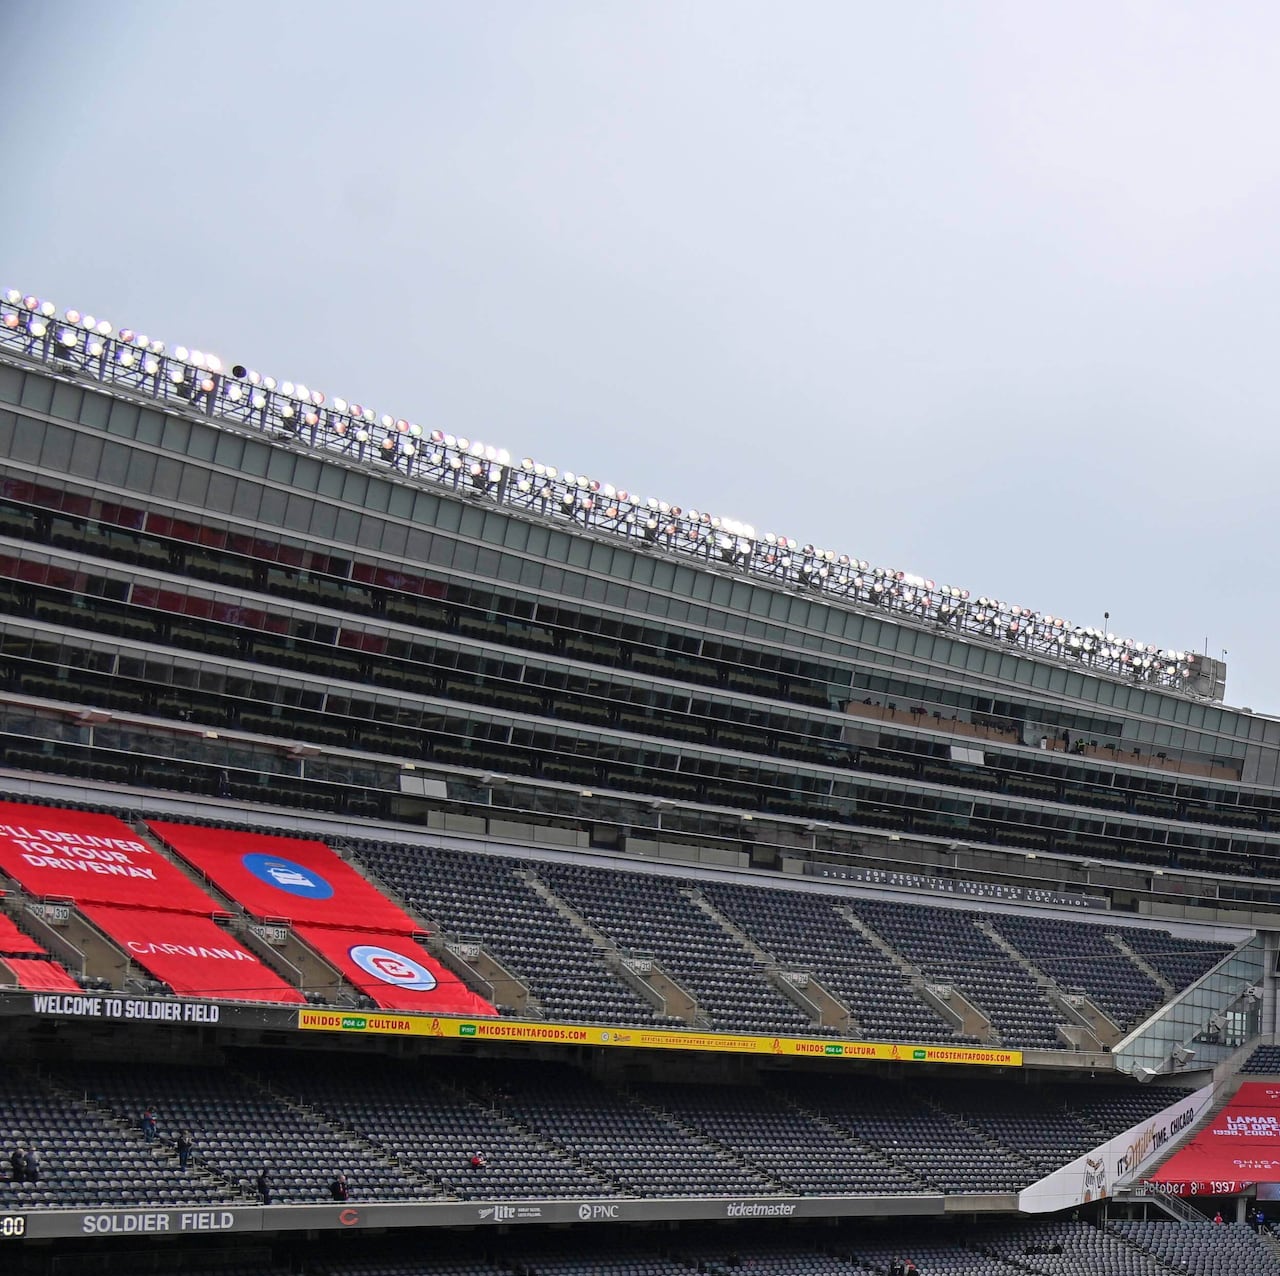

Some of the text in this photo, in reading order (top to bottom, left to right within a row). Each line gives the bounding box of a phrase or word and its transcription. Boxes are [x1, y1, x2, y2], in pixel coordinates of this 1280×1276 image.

[37, 828, 152, 854] DELIVER
[12, 839, 134, 865] TO YOUR
[21, 853, 158, 881] DRIVEWAY
[54, 907, 69, 919] 310
[274, 929, 286, 940] 311
[127, 941, 255, 962] CARVANA
[34, 994, 220, 1023] WELCOME TO SOLDIER FIELD
[303, 1014, 587, 1040] UNIDOS CULTURA MICOSTENITAFOODS.COM
[796, 1043, 1011, 1063] UNIDOS CULTURA MICOSTENITAFOODS.COM
[1226, 1116, 1276, 1125] LAMAR
[1117, 1107, 1194, 1176] IT'S TIME, CHICAGO
[1210, 1181, 1236, 1194] 1997
[494, 1206, 515, 1222] Lite
[593, 1206, 619, 1218] PNC
[727, 1203, 796, 1216] ticketmaster
[83, 1212, 234, 1233] SOLDIER FIELD
